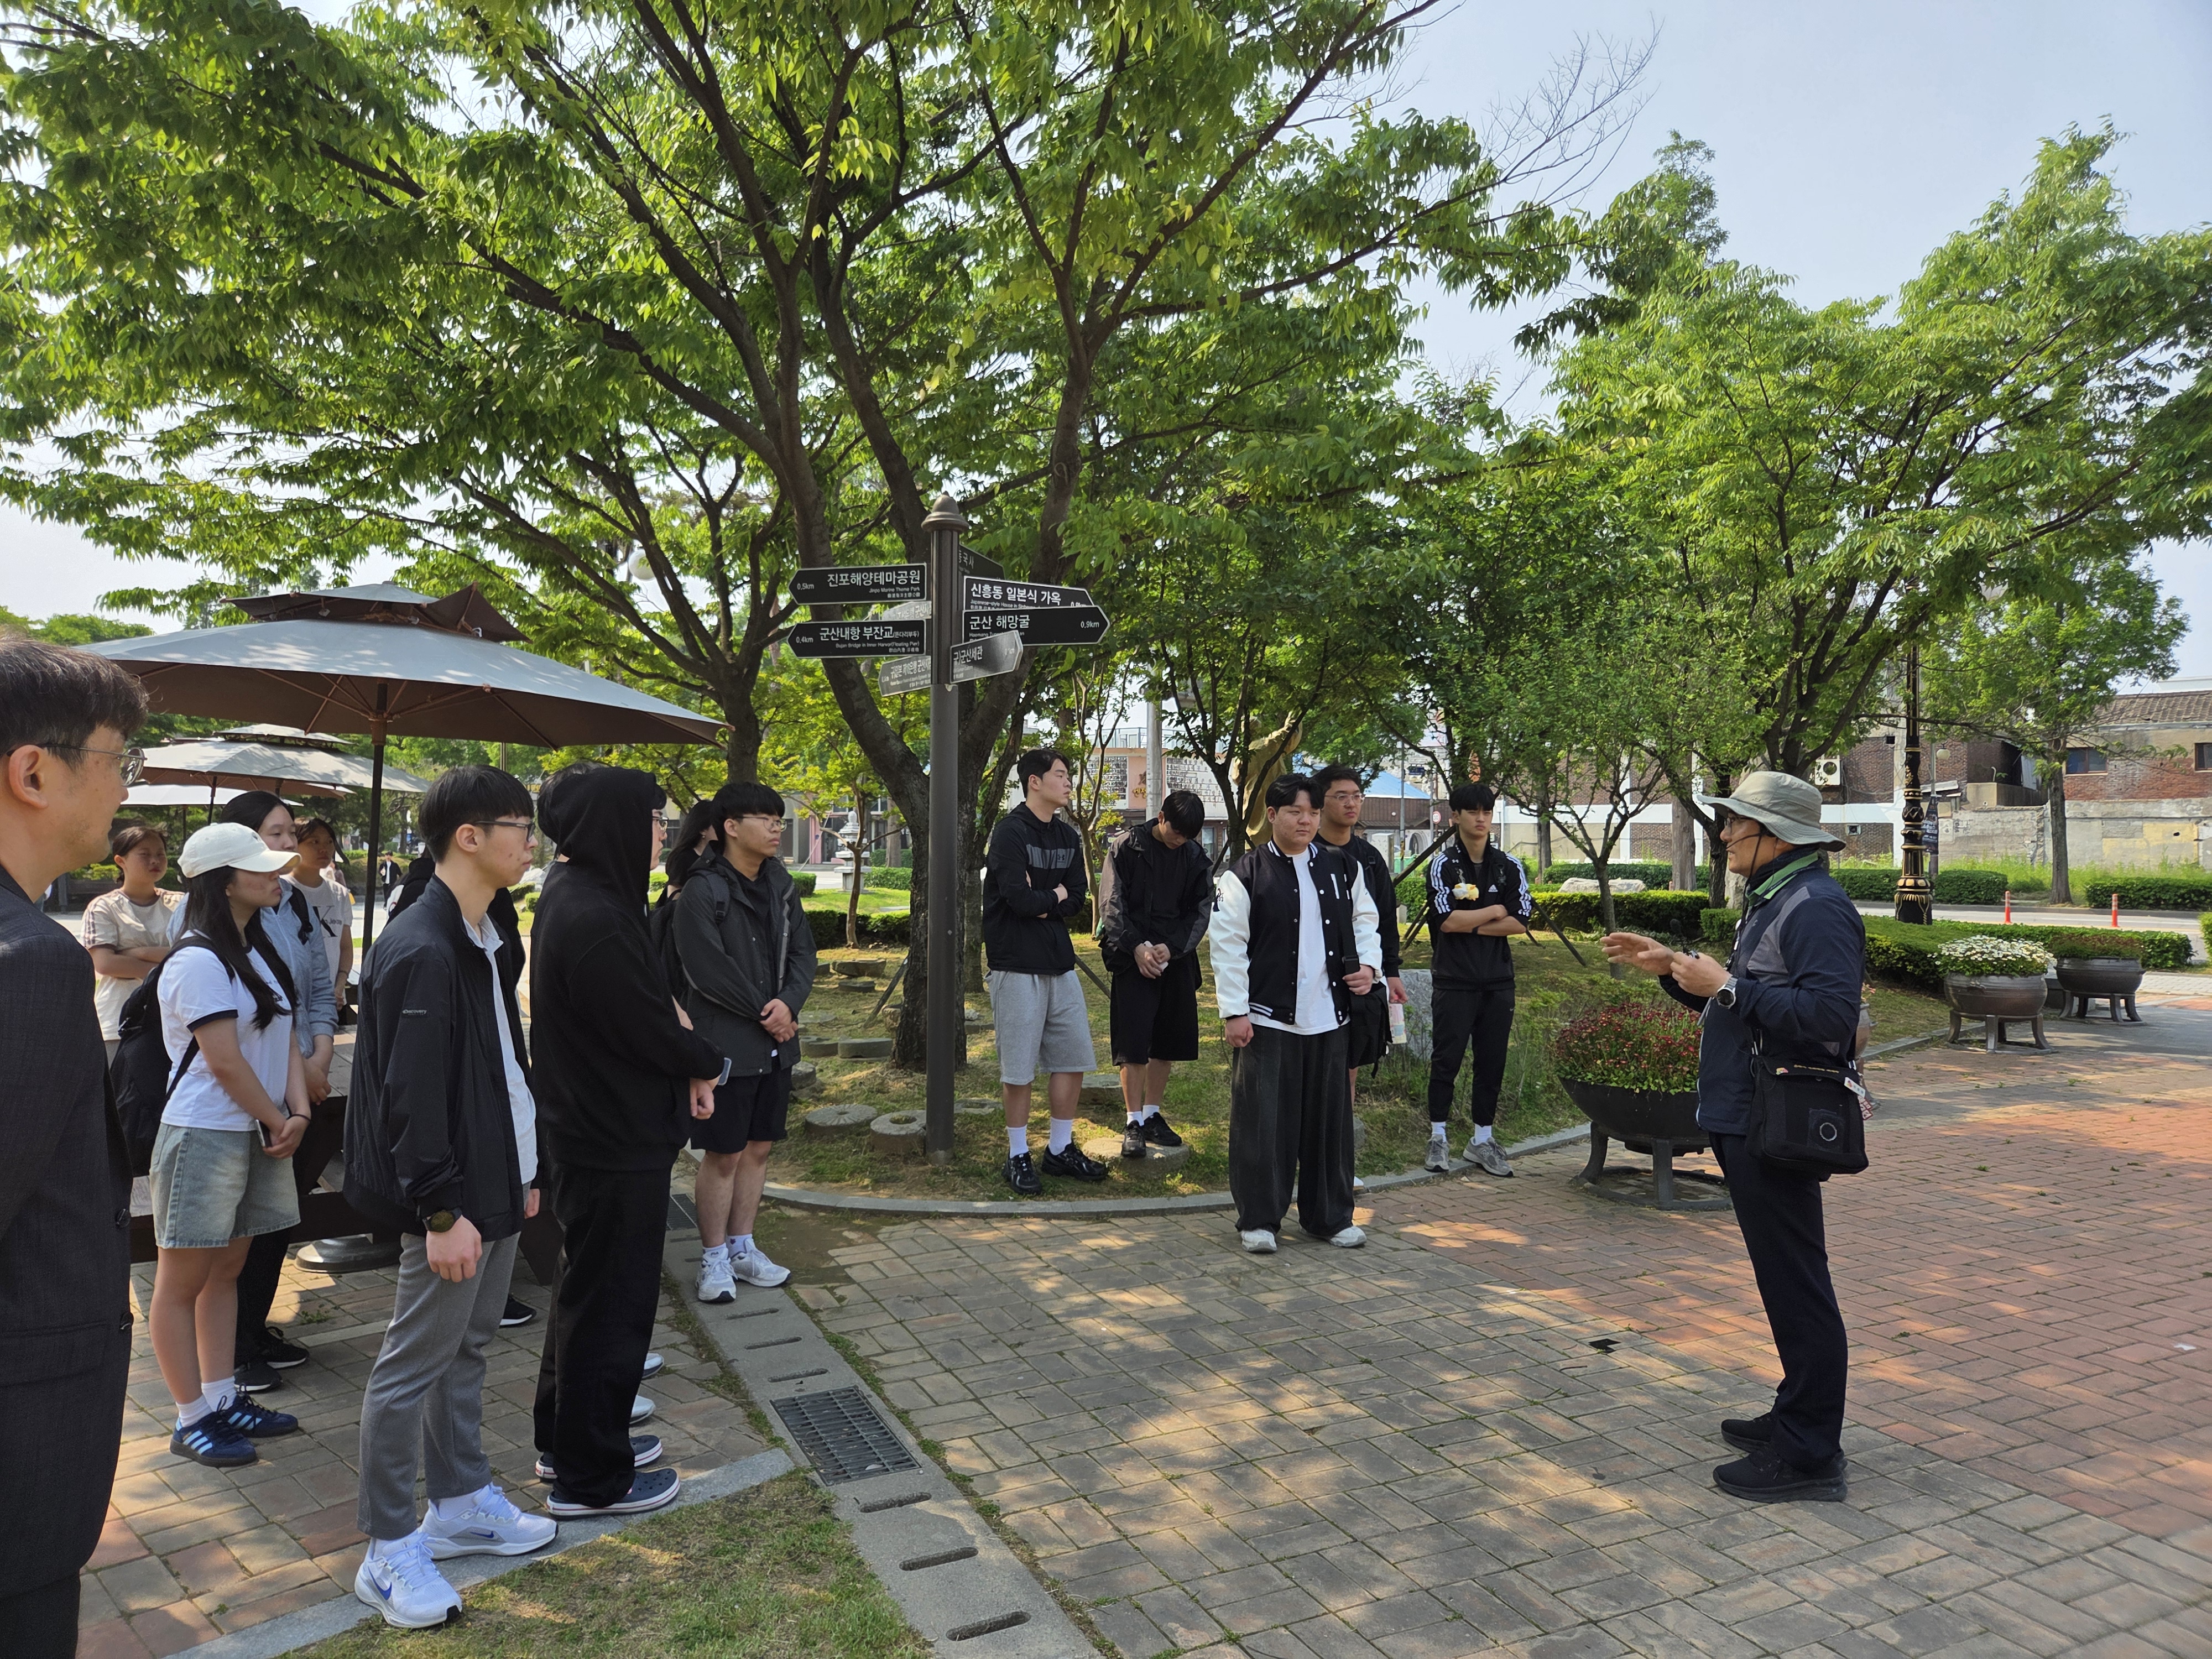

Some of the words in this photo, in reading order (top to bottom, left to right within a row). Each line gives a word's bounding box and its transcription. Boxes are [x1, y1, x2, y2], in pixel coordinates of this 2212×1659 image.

[827, 570, 920, 587] 진포해양테마공원
[971, 583, 1003, 599] 신흥동
[1006, 587, 1037, 603] 일본식
[1041, 591, 1061, 606] 가옥
[969, 616, 992, 630] 군산
[996, 615, 1030, 629] 해망굴
[1080, 620, 1099, 629] 0.9km
[796, 635, 814, 644] 0.4km
[820, 627, 861, 641] 군산내항
